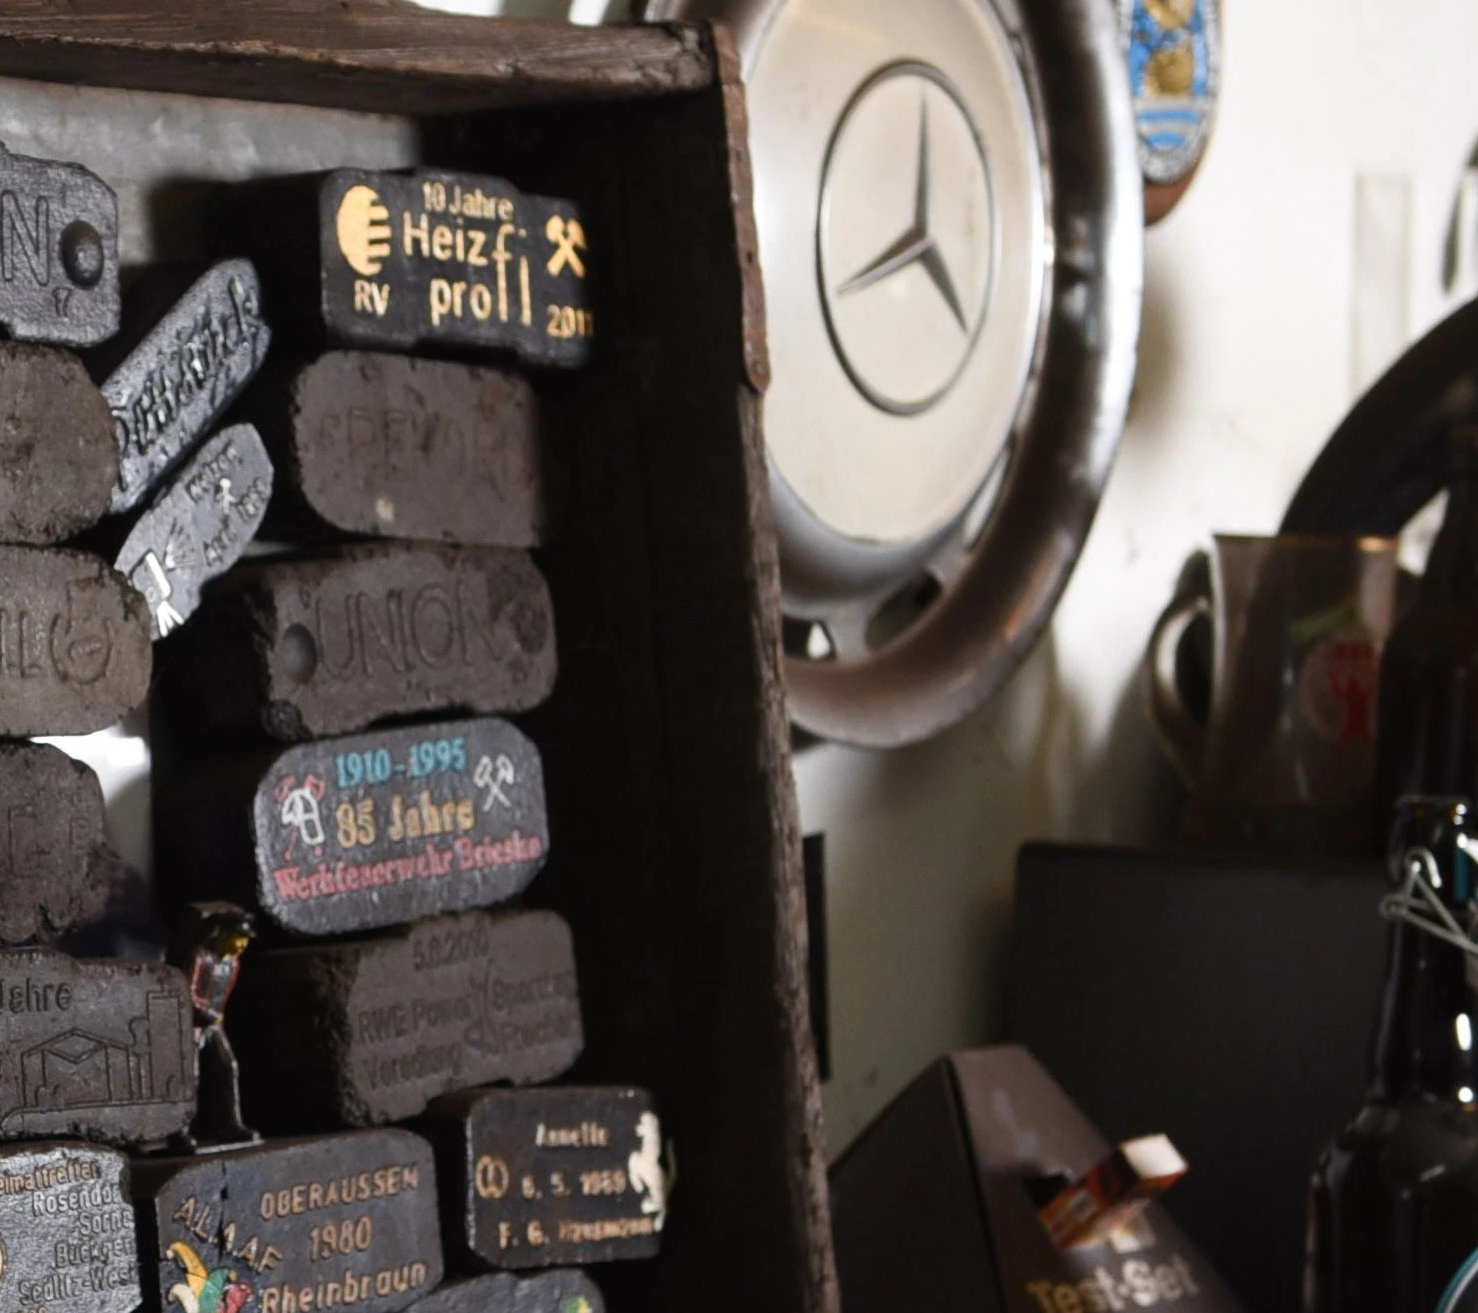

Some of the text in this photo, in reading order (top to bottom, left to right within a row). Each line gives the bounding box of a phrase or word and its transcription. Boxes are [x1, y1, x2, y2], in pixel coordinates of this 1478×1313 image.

[423, 182, 514, 220] 10 Jahre
[403, 210, 488, 266] Heiz
[354, 279, 390, 317] RV
[313, 577, 506, 680] UNION
[336, 790, 475, 848] 85 Jahre
[310, 1216, 373, 1262] 1980
